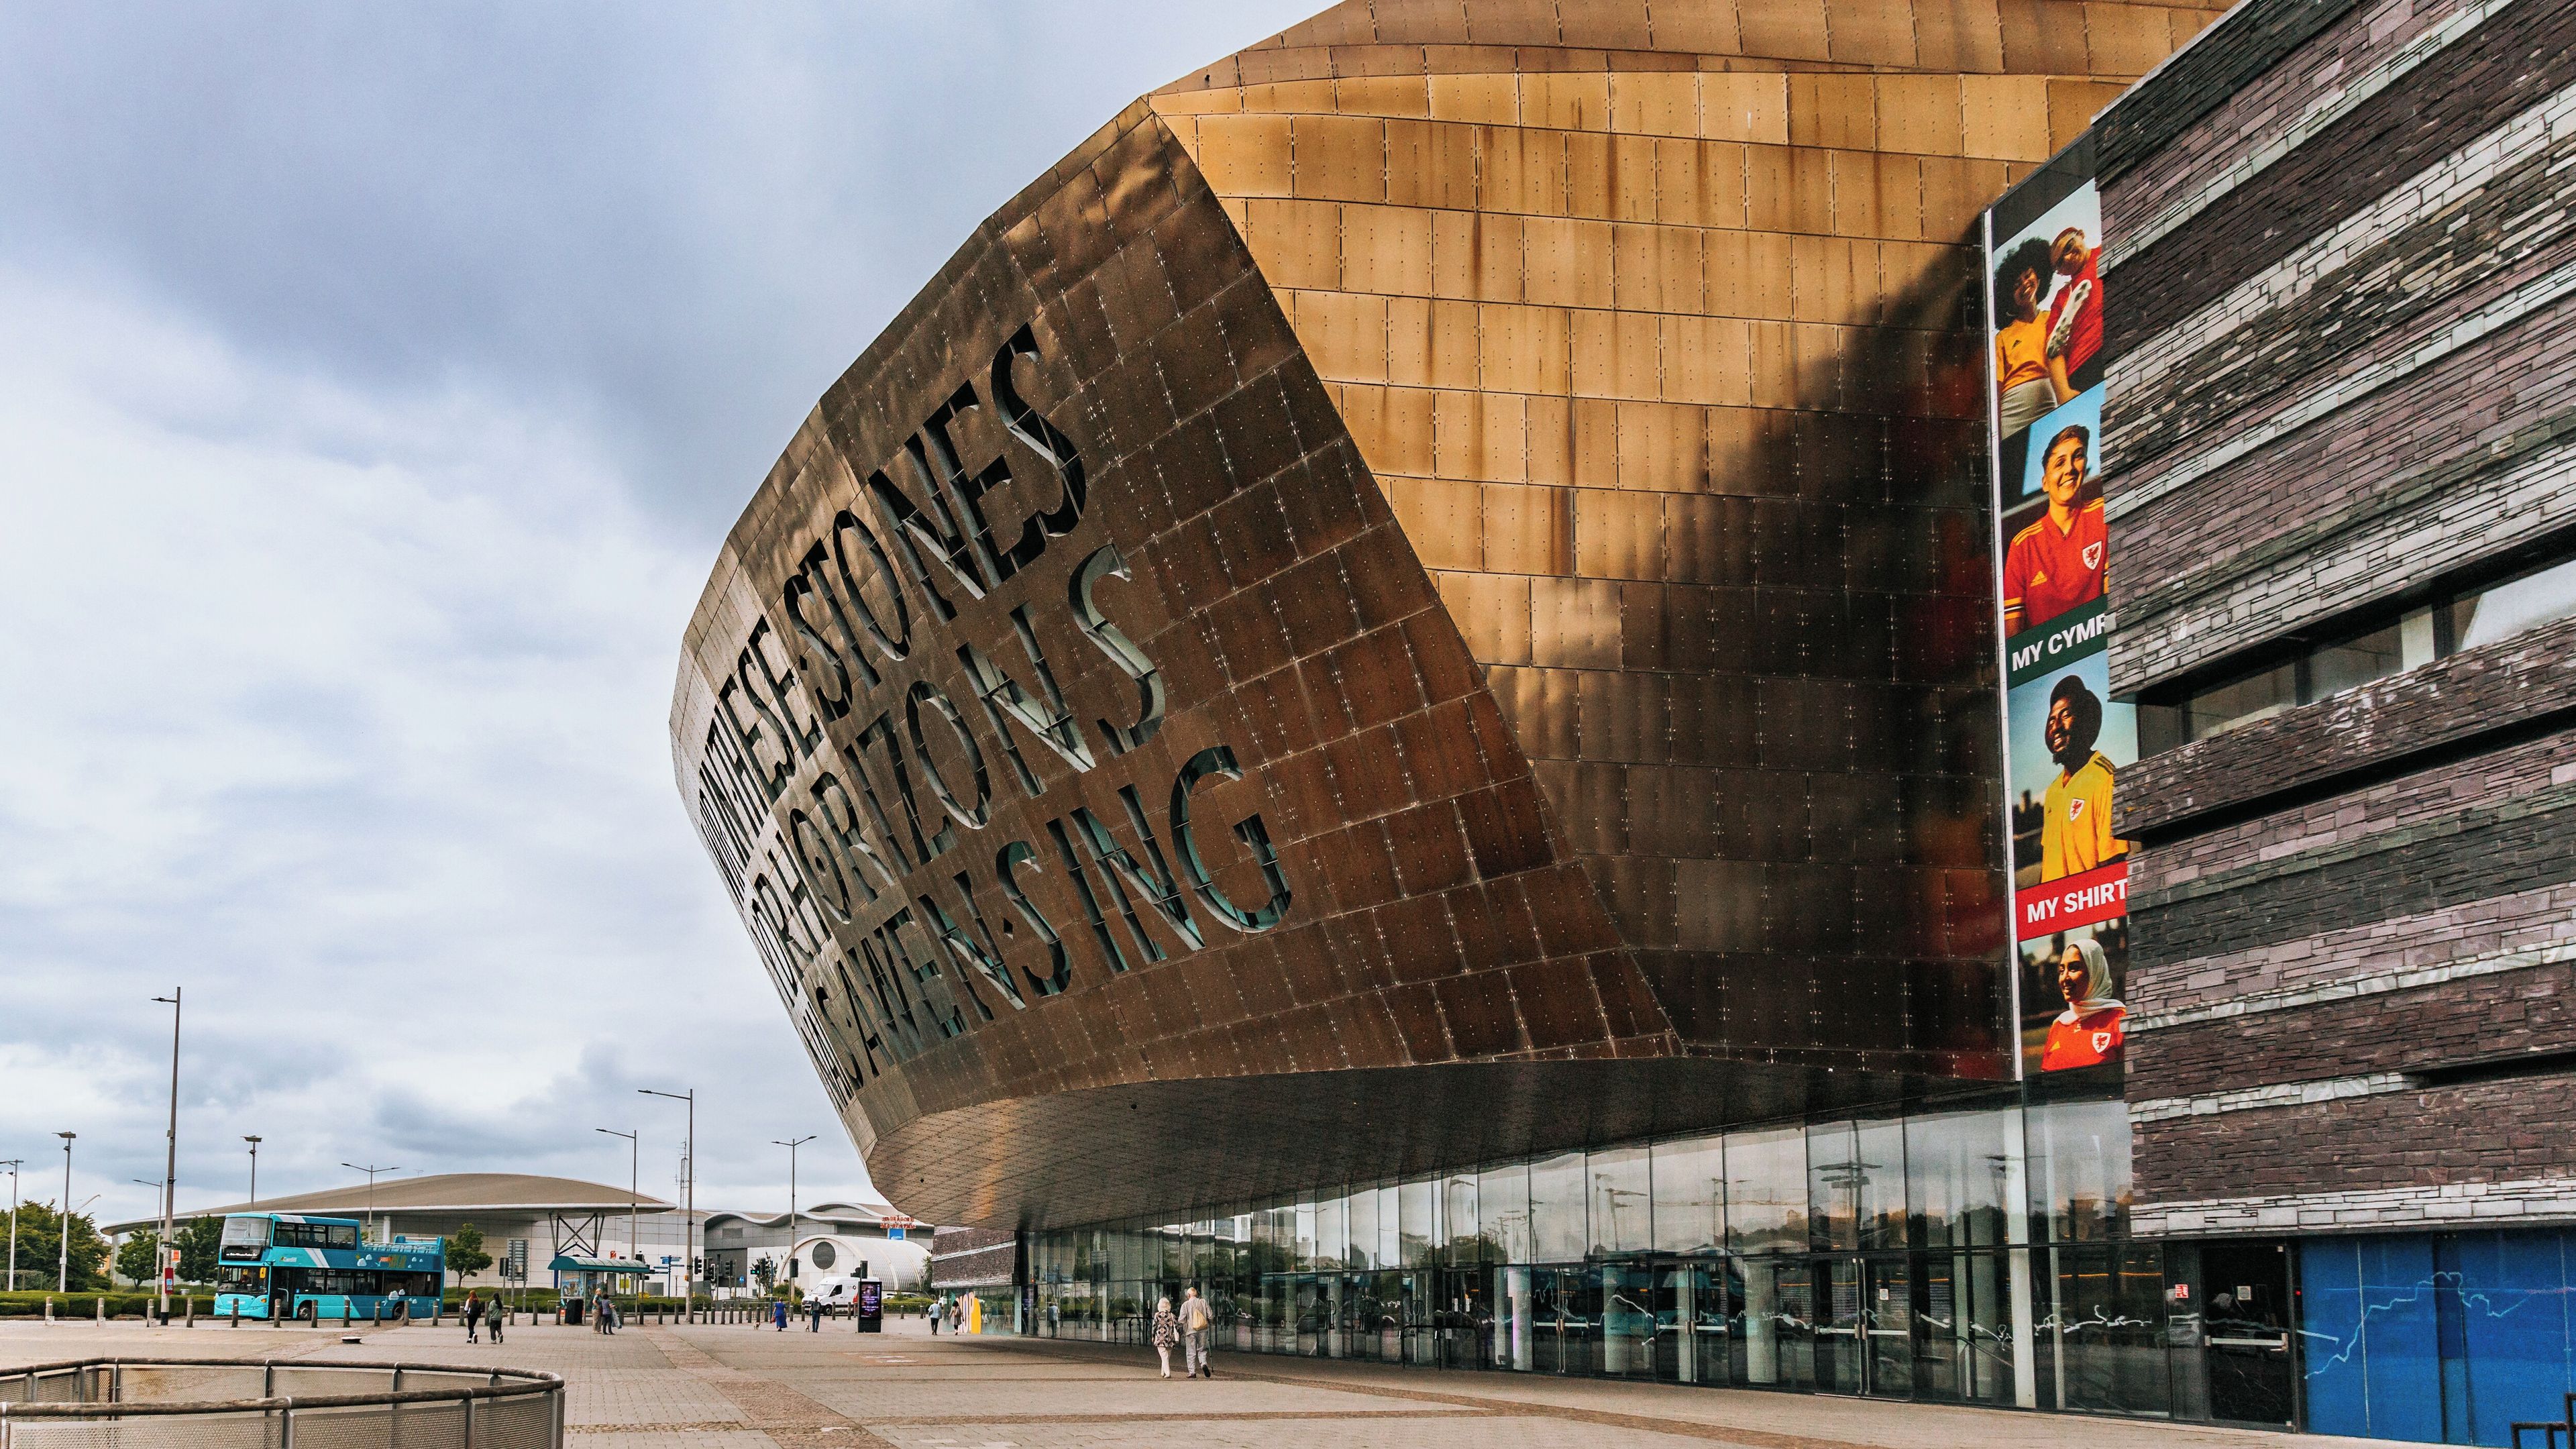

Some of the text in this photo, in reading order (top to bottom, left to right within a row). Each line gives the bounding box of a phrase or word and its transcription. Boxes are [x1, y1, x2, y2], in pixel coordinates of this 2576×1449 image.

[706, 613, 824, 839] THESE
[784, 323, 1086, 723] STONES
[2012, 640, 2043, 672] MY
[767, 543, 1164, 954] HORIZONS
[996, 745, 1292, 998] SING
[2027, 878, 2127, 923] MY SHIRT
